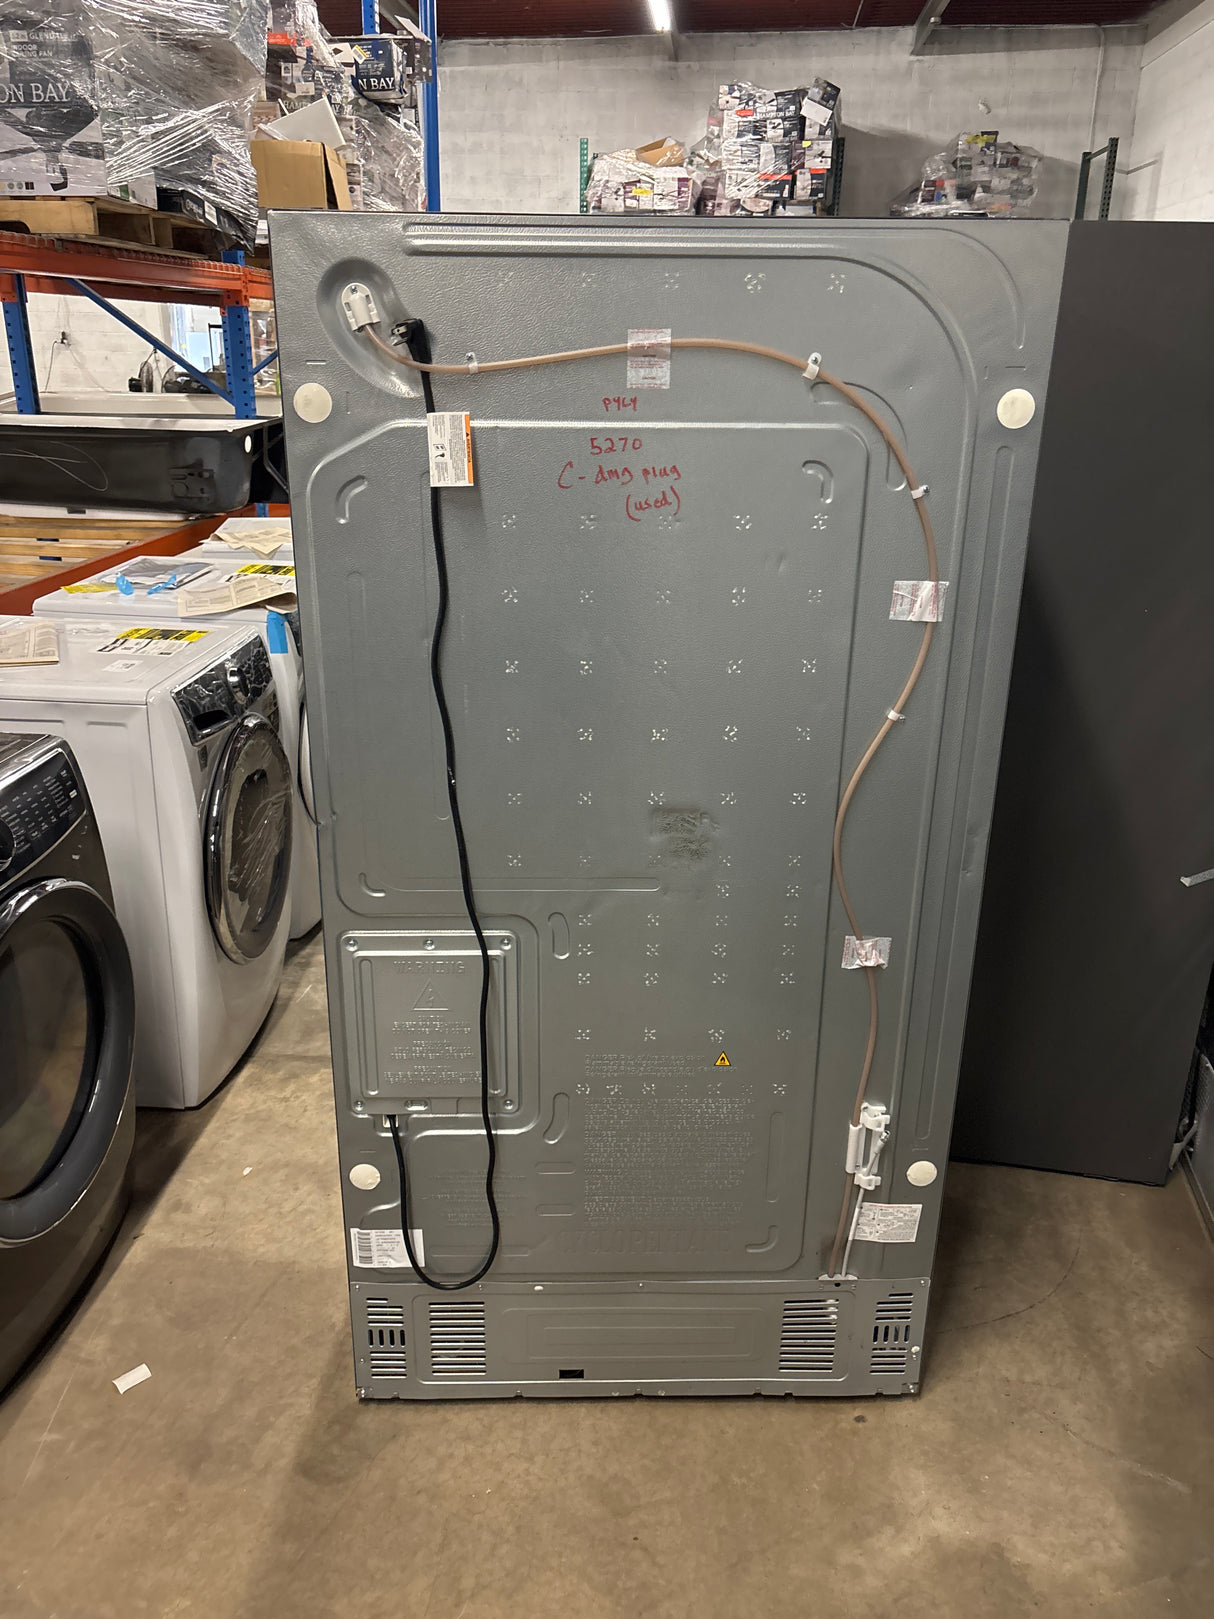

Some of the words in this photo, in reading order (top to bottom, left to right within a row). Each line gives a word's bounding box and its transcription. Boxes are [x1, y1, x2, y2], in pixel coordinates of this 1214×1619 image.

[30, 83, 71, 103] BAY
[370, 77, 395, 90] BAY
[590, 437, 643, 456] 5270
[641, 464, 681, 485] plug
[625, 485, 681, 522] (used)
